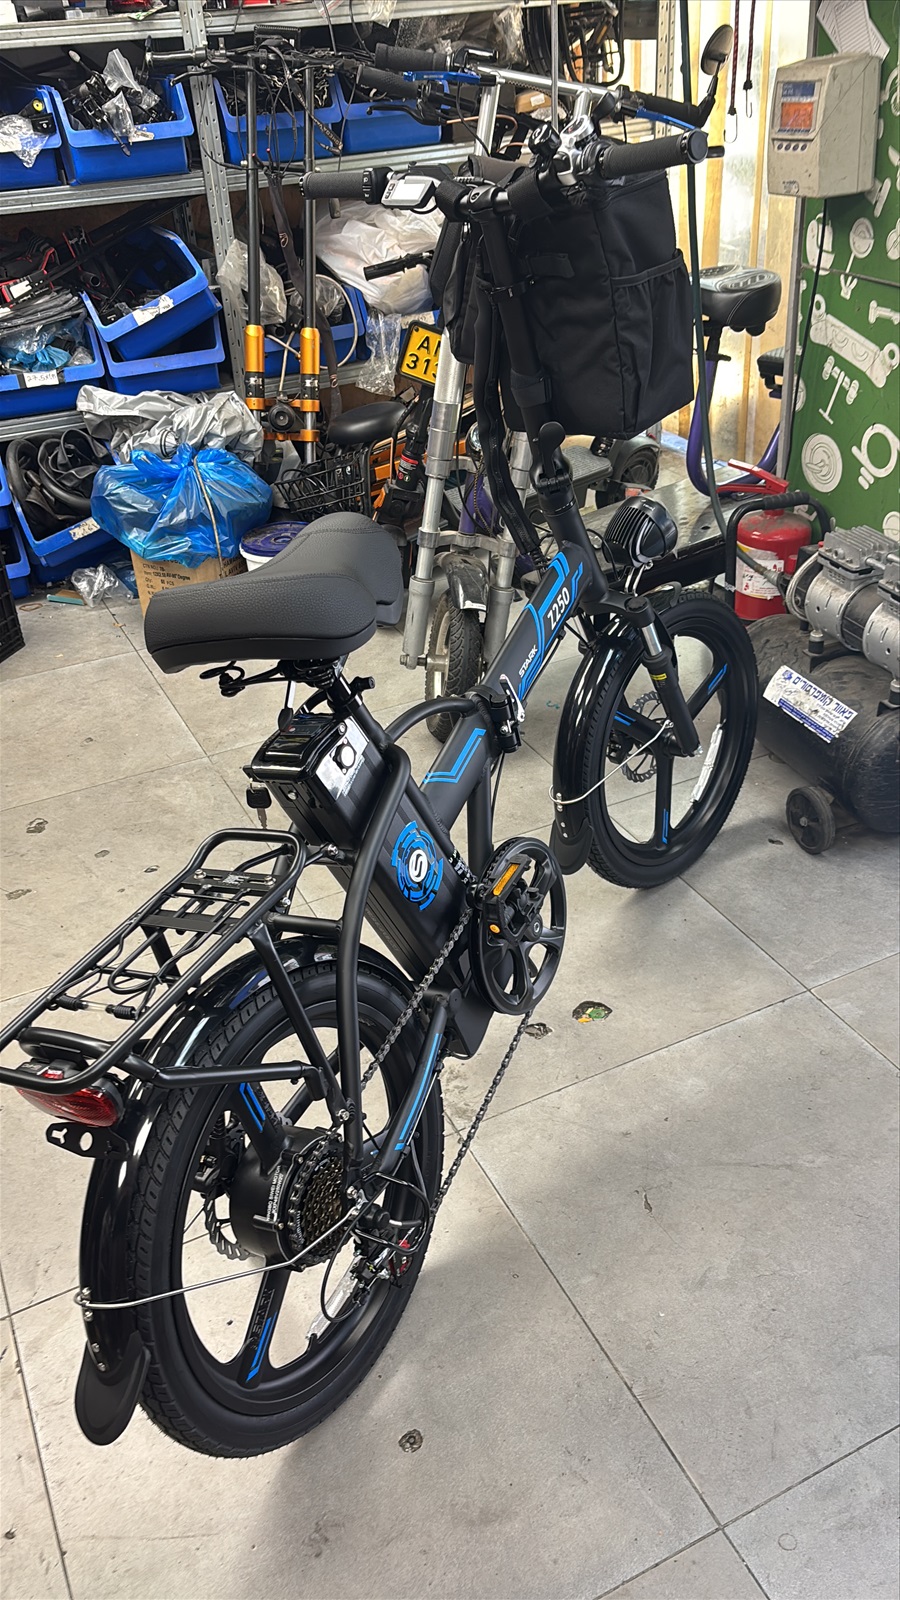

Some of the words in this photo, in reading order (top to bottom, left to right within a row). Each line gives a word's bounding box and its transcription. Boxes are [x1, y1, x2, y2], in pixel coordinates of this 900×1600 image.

[547, 586, 570, 631] Z250
[518, 645, 538, 678] STARK
[833, 702, 854, 720] פאוור
[272, 1165, 281, 1184] MOTOR
